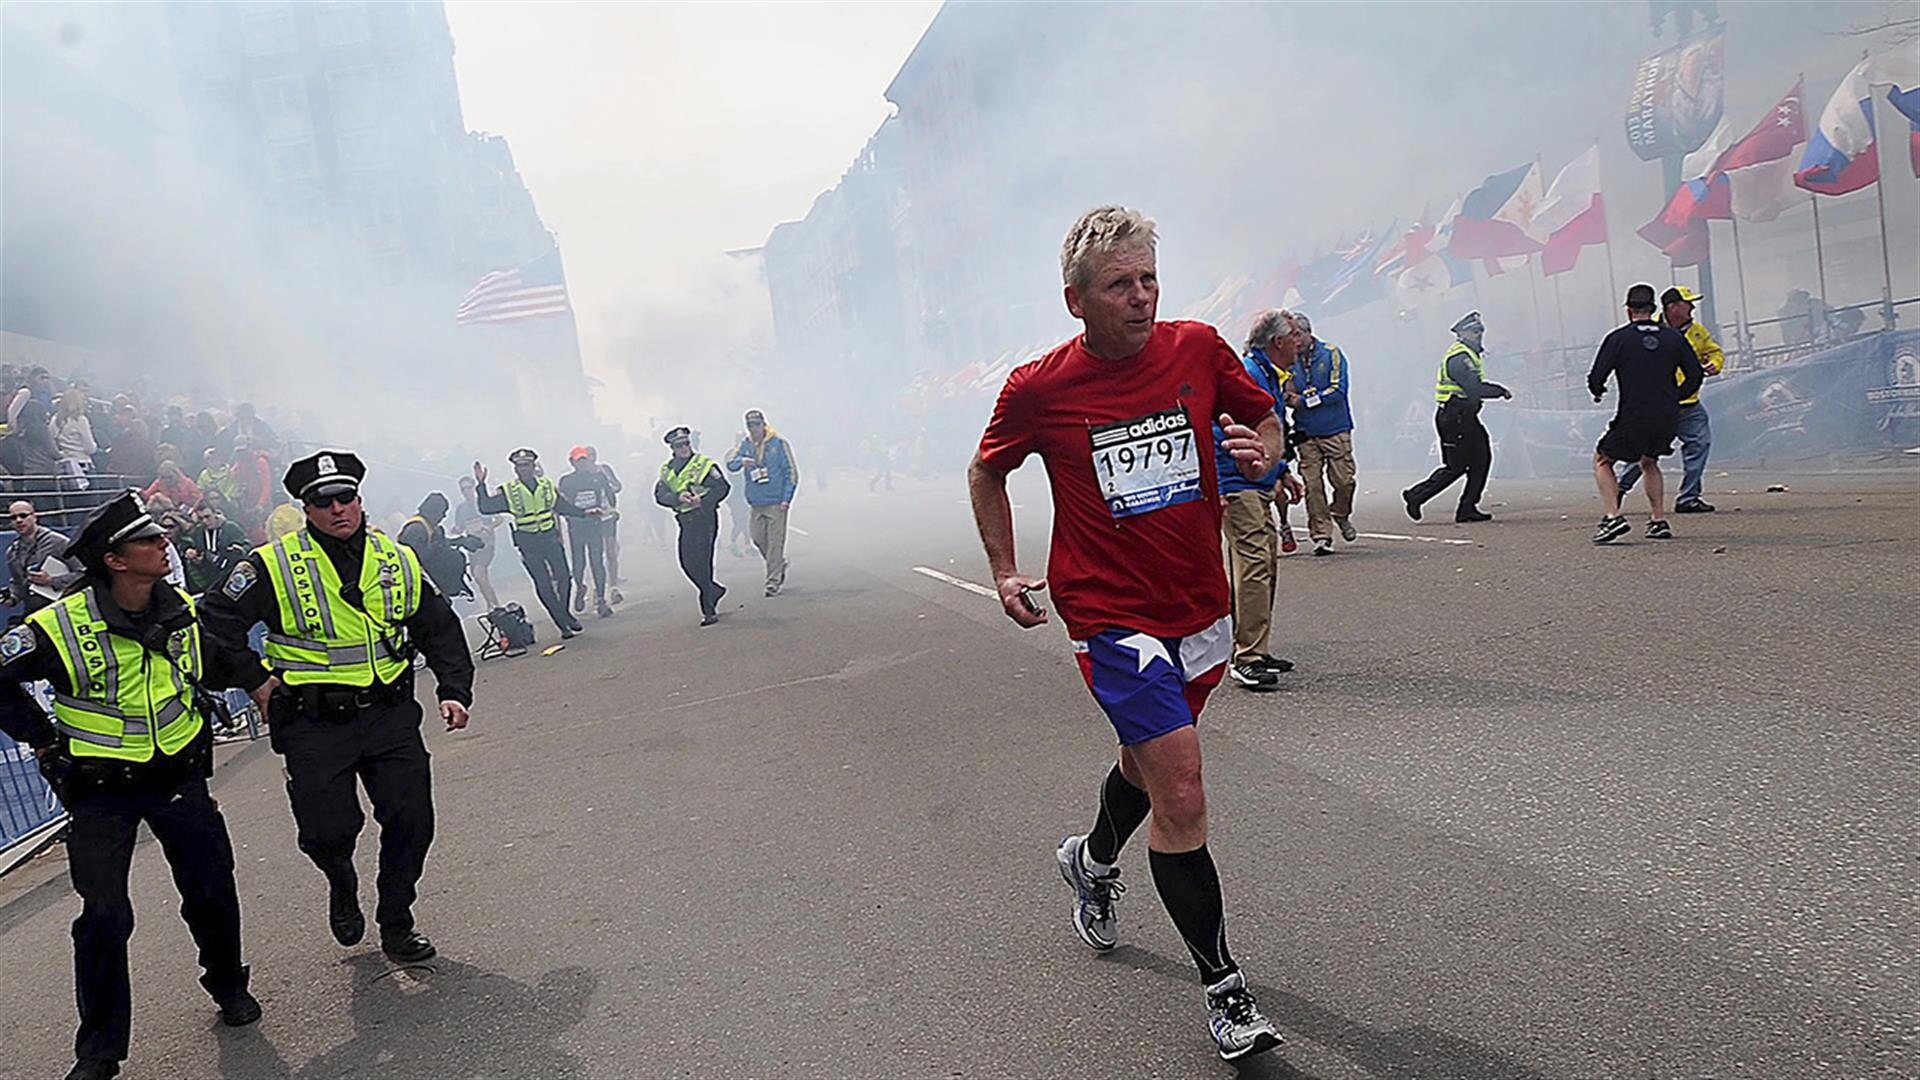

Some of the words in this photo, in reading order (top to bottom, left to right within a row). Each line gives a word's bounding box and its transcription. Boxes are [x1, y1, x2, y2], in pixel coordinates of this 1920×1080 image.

[1642, 57, 1661, 145] MARATHON
[1129, 414, 1187, 437] adidas
[1100, 433, 1191, 477] 19797
[1107, 482, 1115, 493] 2
[290, 552, 322, 633] BOSTON
[386, 551, 403, 615] POLIC
